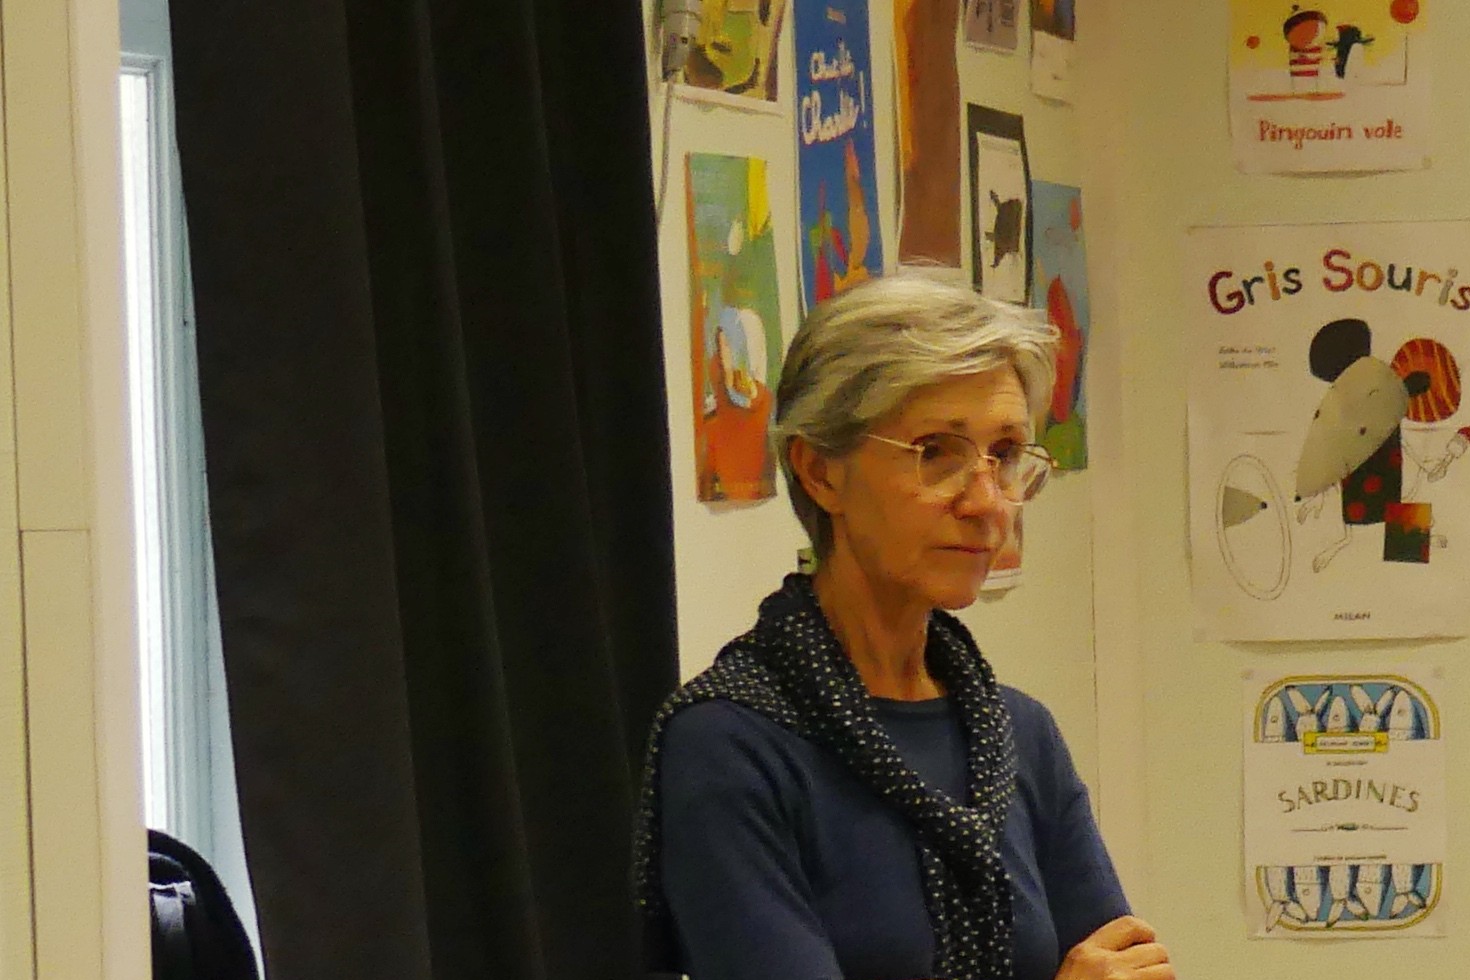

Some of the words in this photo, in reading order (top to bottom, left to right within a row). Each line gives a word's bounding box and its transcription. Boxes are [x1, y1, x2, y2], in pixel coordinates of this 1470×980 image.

[1258, 120, 1353, 150] Pingouin
[1363, 119, 1403, 141] vole
[1207, 260, 1304, 315] Gris
[1333, 610, 1372, 621] MILAN
[1276, 777, 1421, 815] SARDINES
